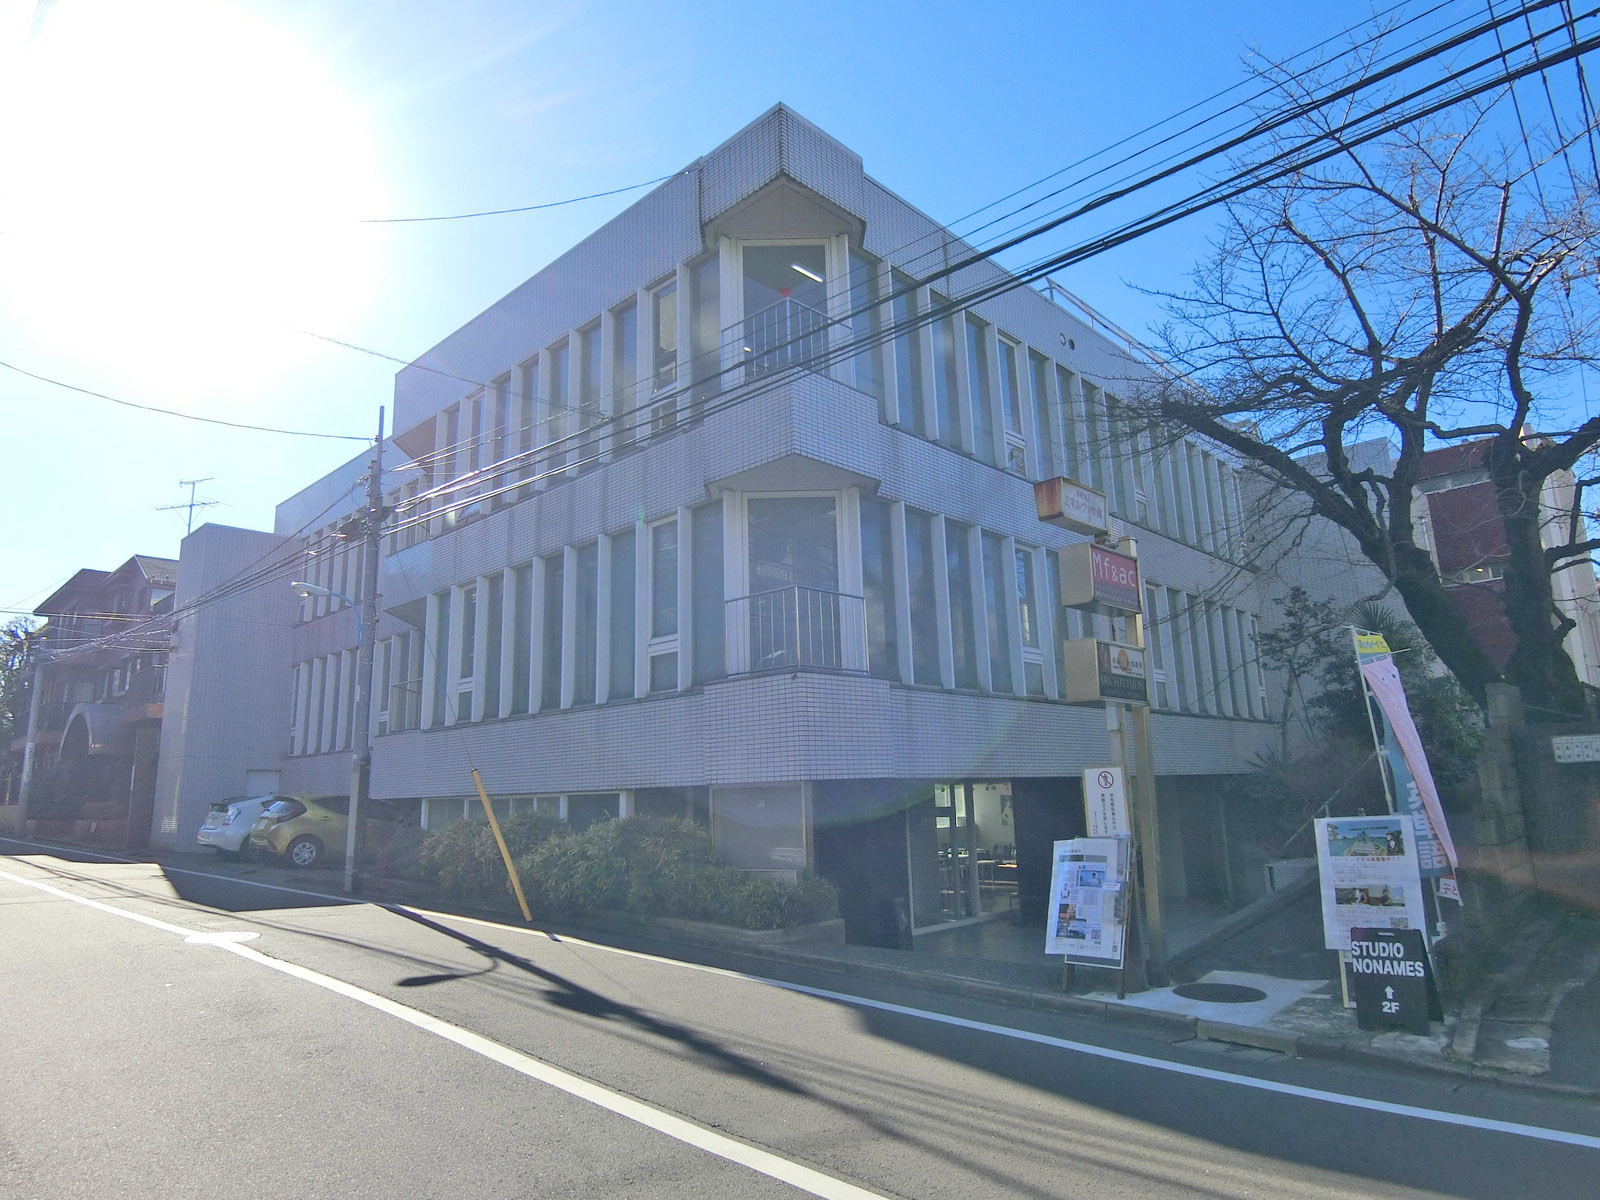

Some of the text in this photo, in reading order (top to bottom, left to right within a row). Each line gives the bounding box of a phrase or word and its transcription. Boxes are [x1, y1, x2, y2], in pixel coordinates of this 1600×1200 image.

[1093, 553, 1136, 587] Mf&ac
[1351, 940, 1404, 959] STUDIO
[1352, 958, 1425, 977] NONAMES
[1381, 1001, 1400, 1014] 2F
